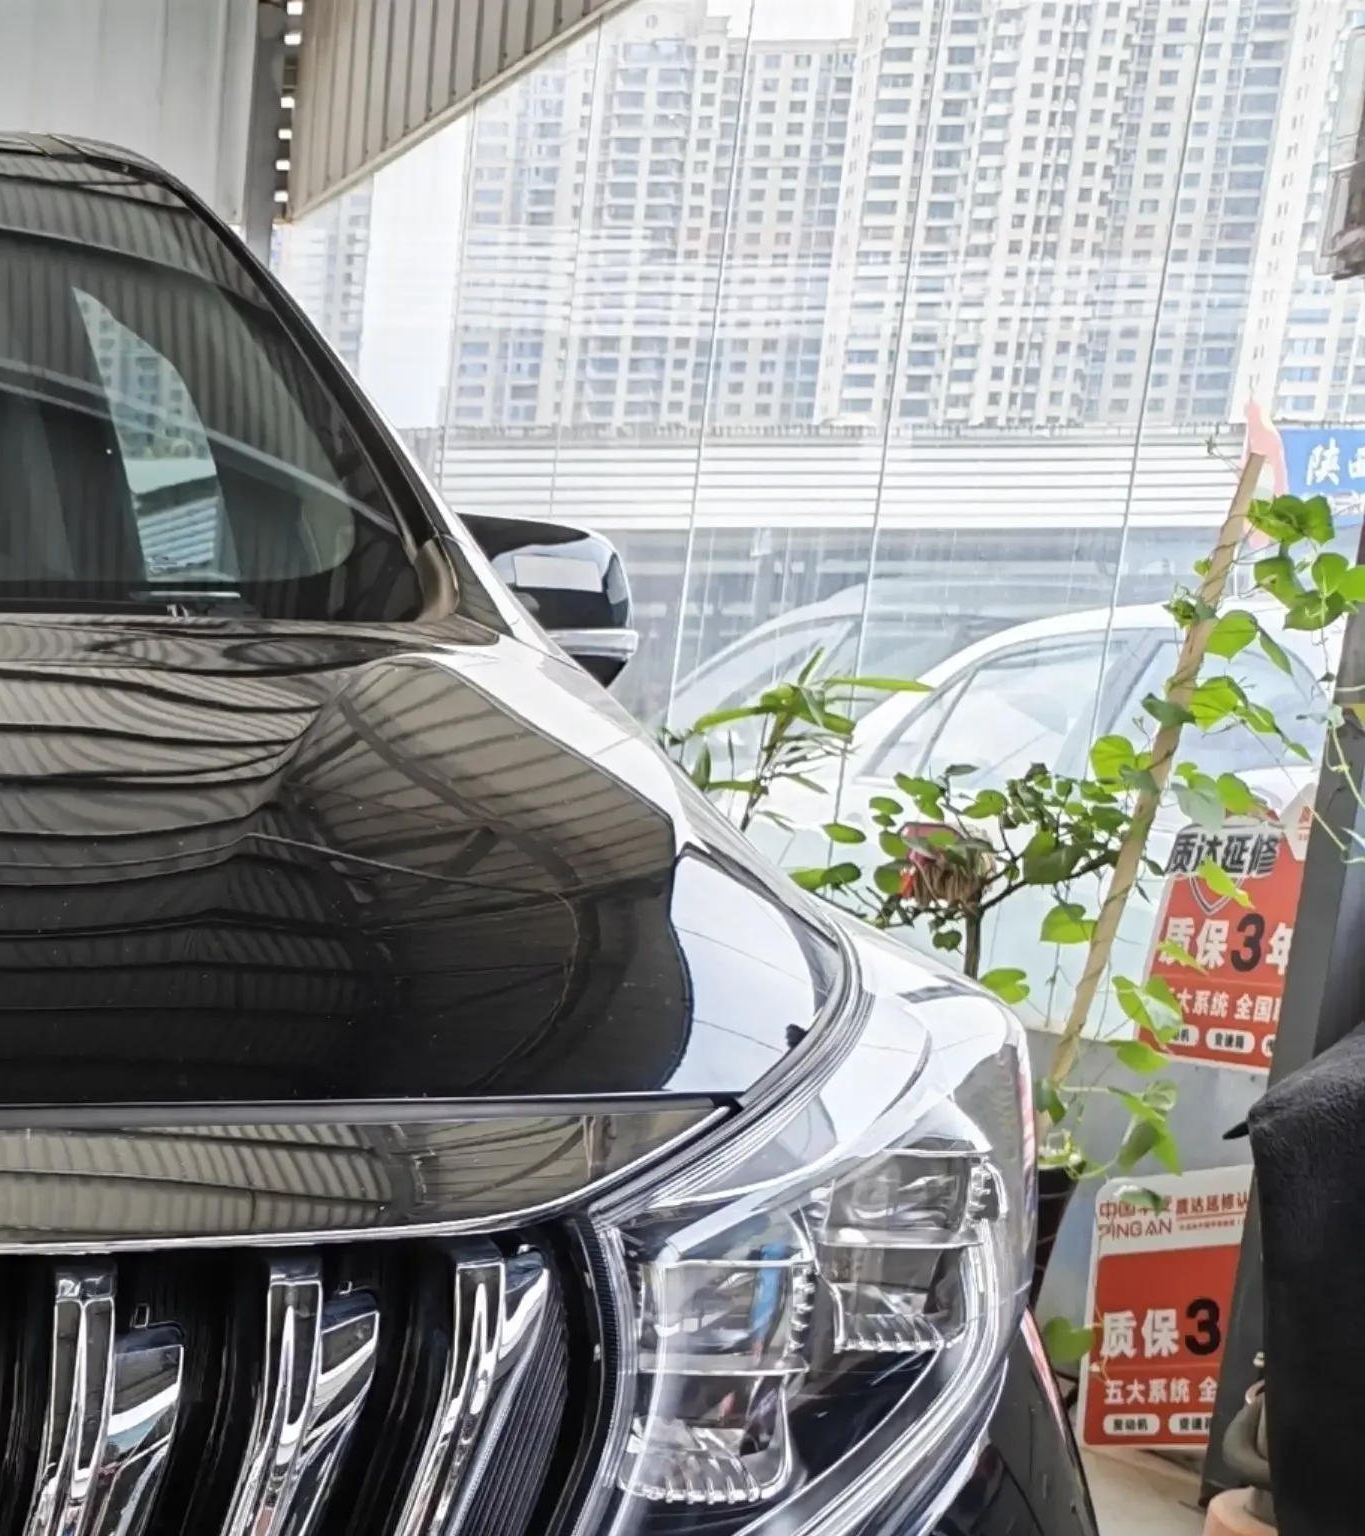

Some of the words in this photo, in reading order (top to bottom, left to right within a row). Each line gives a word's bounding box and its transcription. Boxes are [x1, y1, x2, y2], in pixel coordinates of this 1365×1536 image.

[1166, 832, 1279, 874] 质达延修
[1169, 987, 1229, 1018] 大系统
[1104, 1377, 1190, 1405] 五大系统
